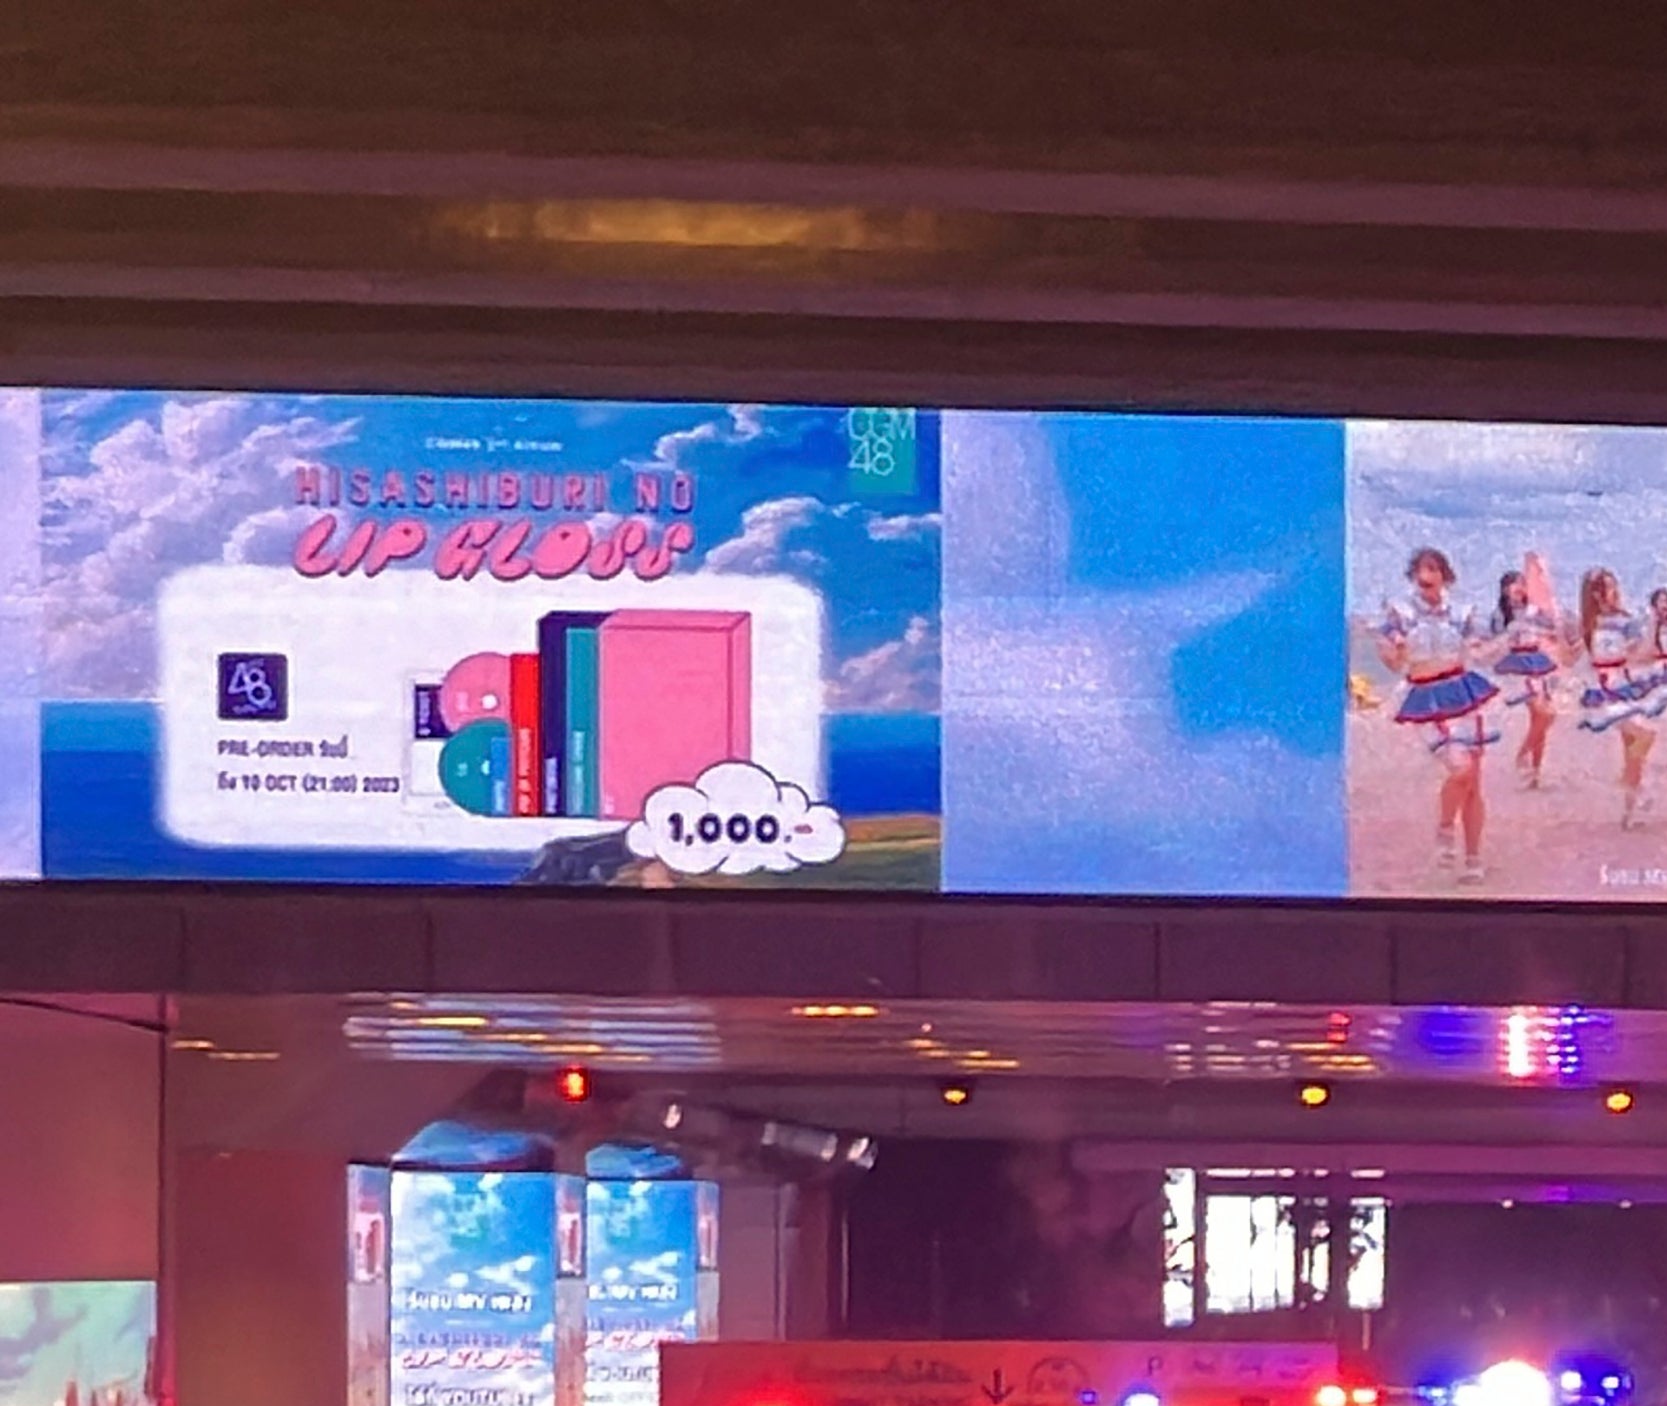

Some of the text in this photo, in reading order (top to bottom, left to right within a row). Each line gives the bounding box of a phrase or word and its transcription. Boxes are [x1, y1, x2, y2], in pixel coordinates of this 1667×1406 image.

[848, 438, 895, 476] 48
[295, 465, 696, 514] HISASHIBURI NO
[293, 513, 695, 582] LIP GLOSS
[217, 739, 314, 758] PRE-ORDER
[265, 773, 298, 792] OCT
[362, 776, 401, 794] 2023
